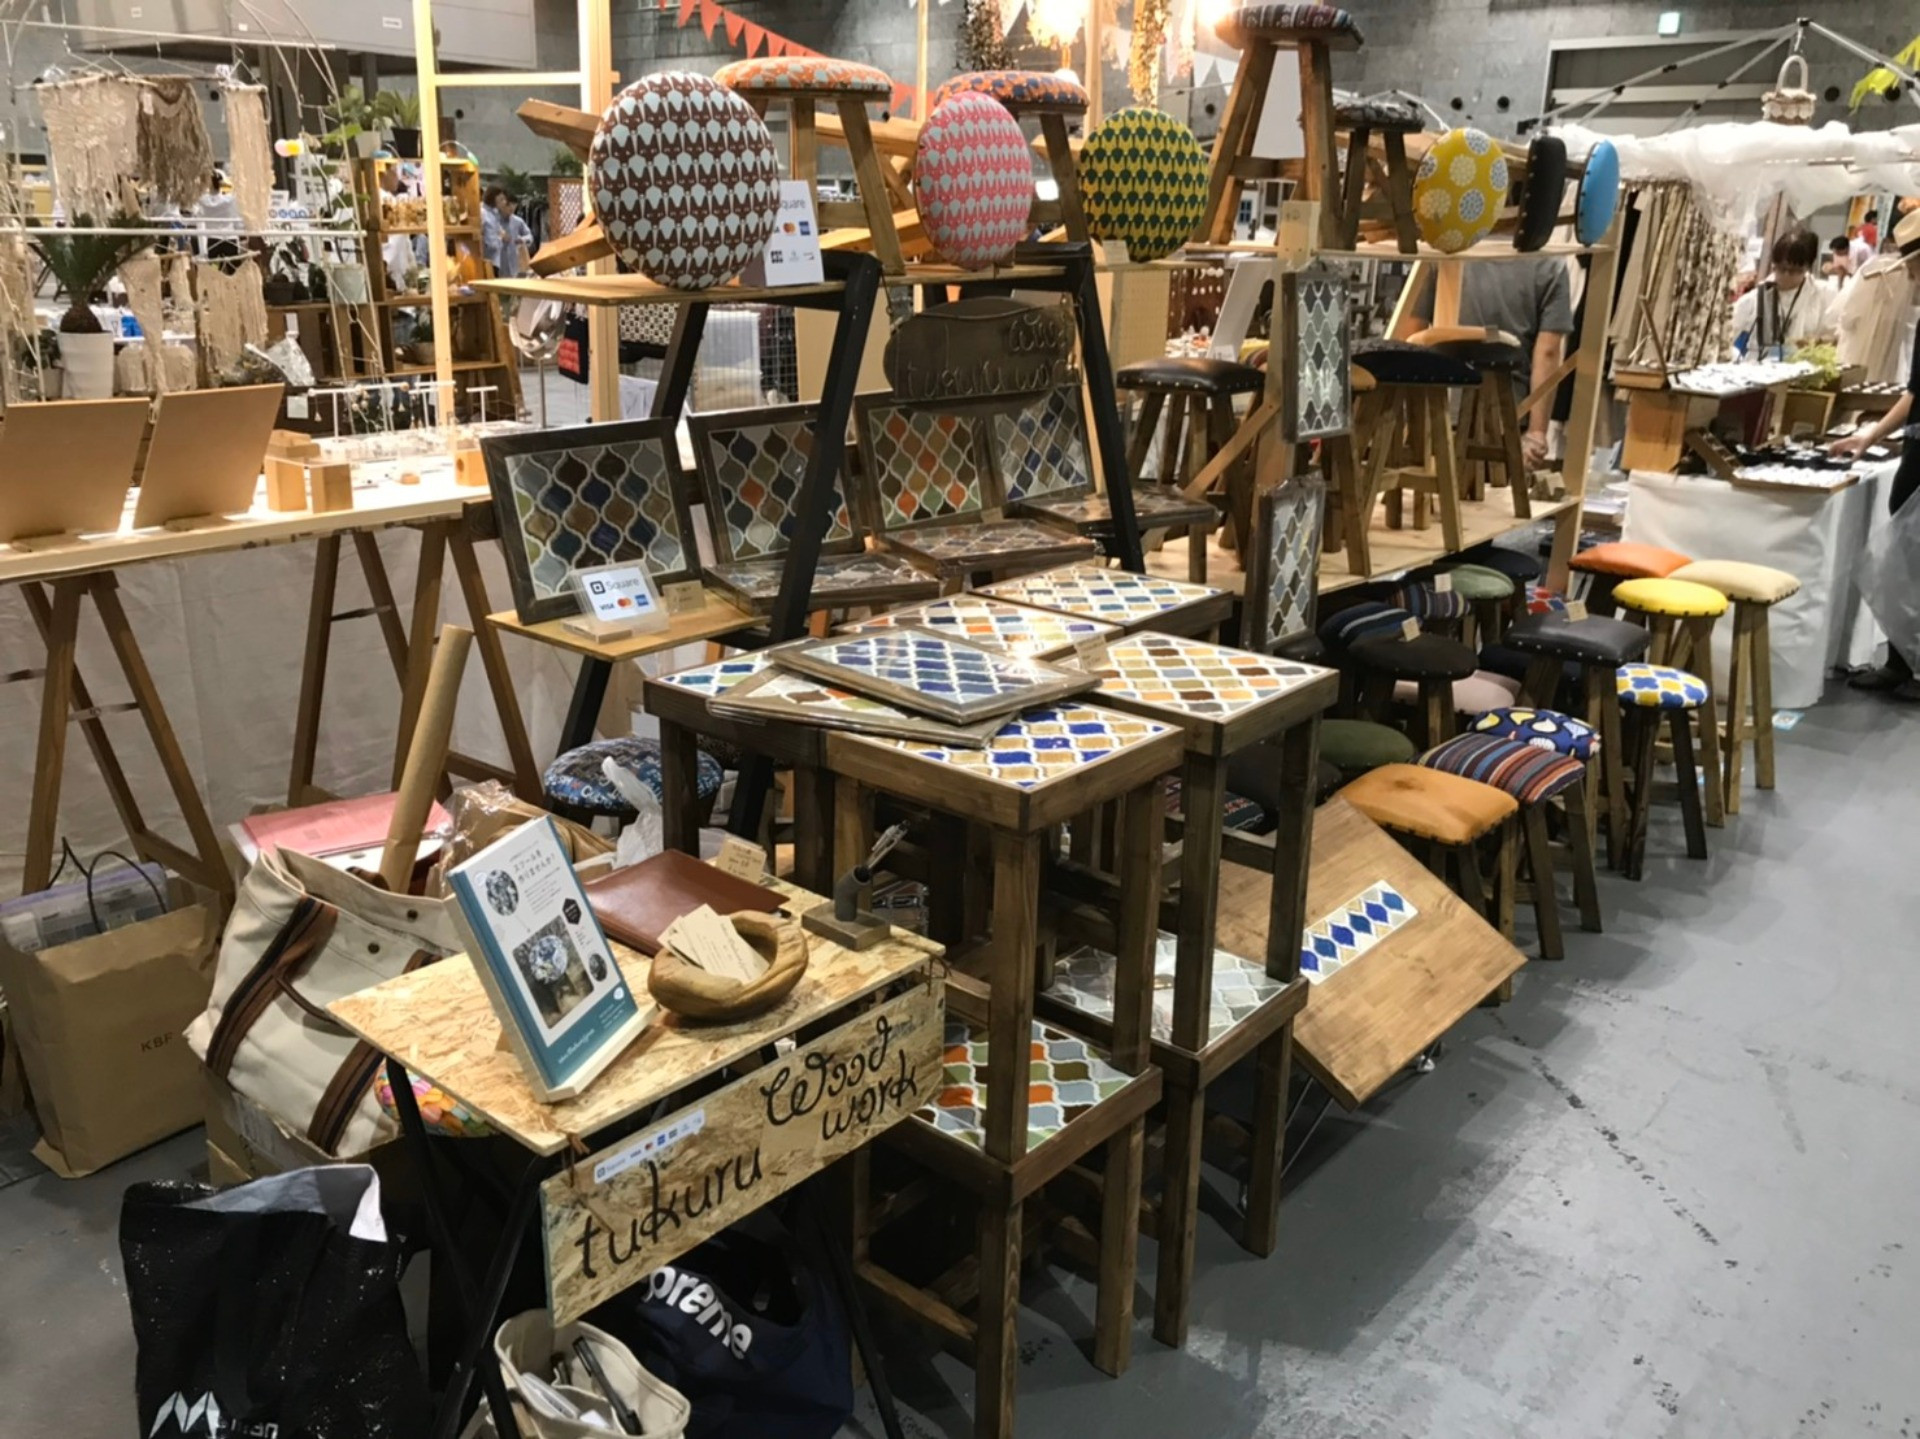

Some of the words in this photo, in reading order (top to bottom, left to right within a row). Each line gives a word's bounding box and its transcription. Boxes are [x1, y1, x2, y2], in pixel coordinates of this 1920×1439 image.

[599, 603, 615, 611] VISA
[605, 578, 640, 591] Square
[140, 1032, 173, 1053] KBF
[761, 1015, 892, 1126] Wood
[820, 1050, 918, 1141] work
[575, 1146, 763, 1278] tukuru
